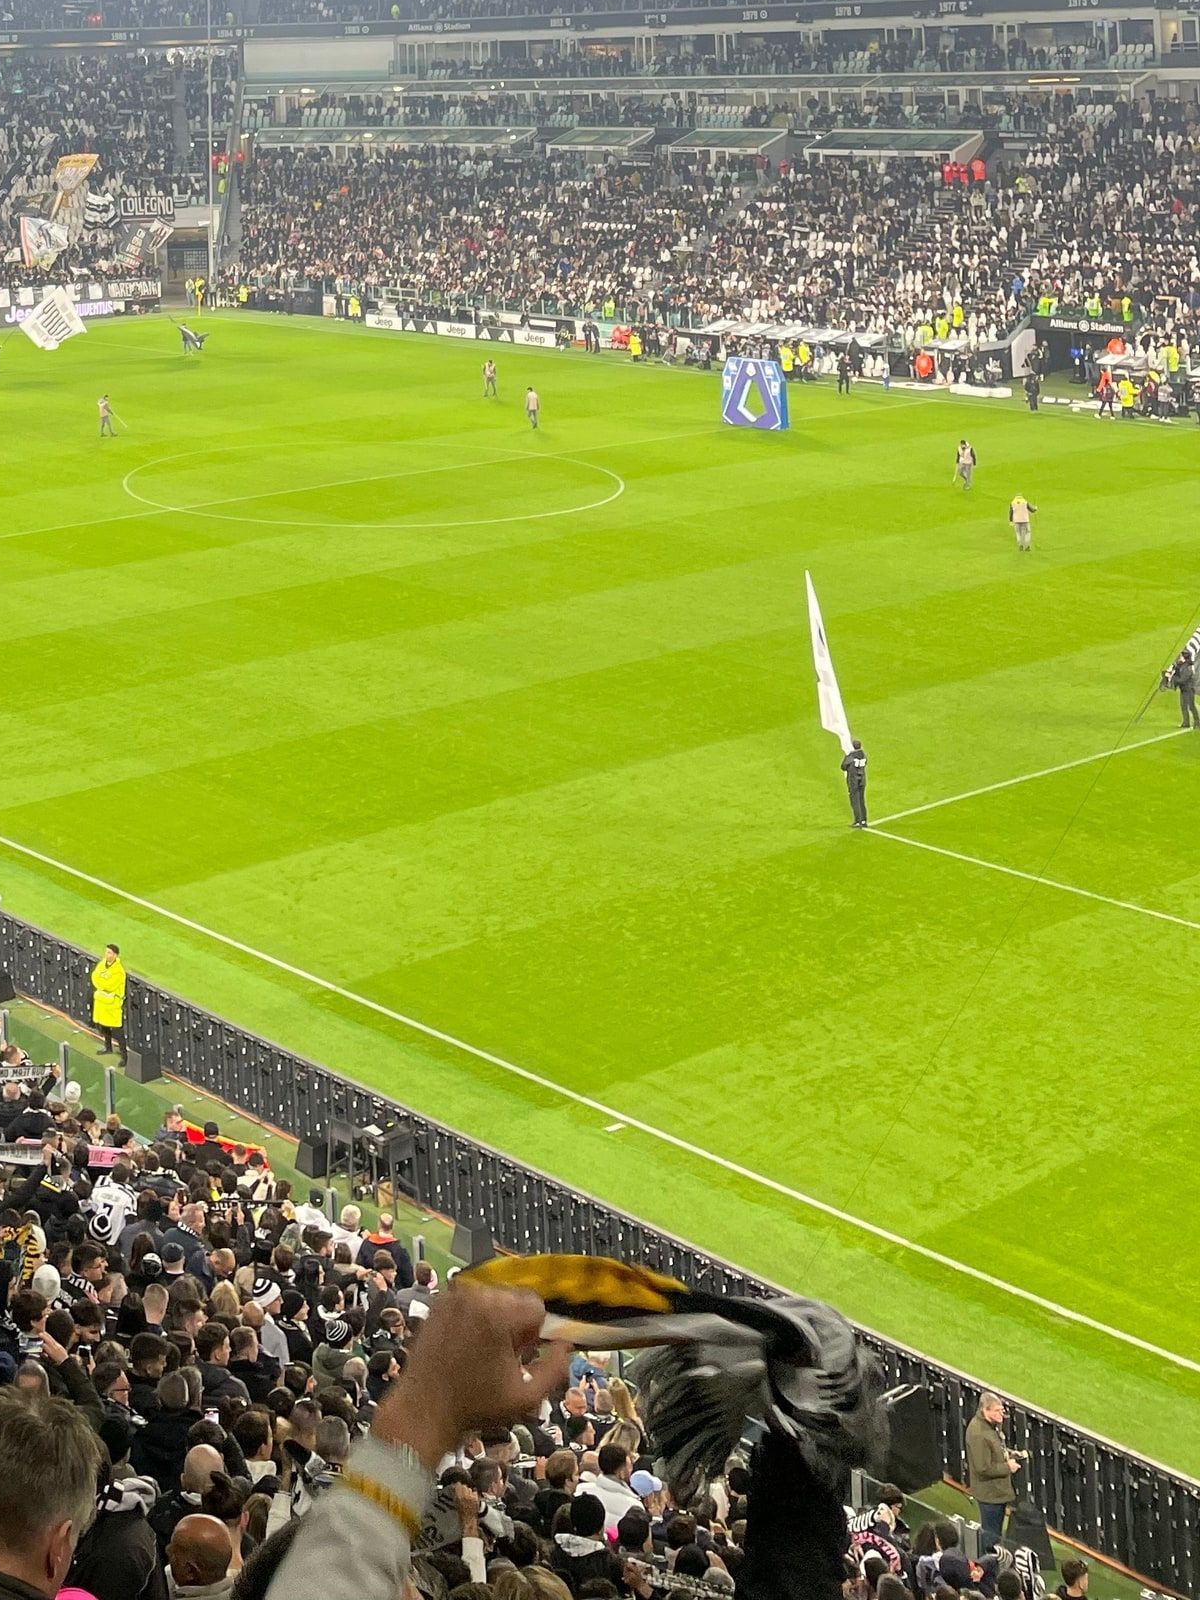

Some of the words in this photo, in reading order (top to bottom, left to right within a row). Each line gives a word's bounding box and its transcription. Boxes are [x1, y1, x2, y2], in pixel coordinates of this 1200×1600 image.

[408, 23, 433, 32] Allianz
[443, 22, 471, 31] Stadium
[120, 196, 174, 216] COLLEGNO
[374, 316, 393, 328] Jeep
[1050, 318, 1078, 330] Allianz
[1090, 321, 1124, 333] Stadium
[446, 323, 466, 335] Jeep
[524, 331, 546, 344] Jeep
